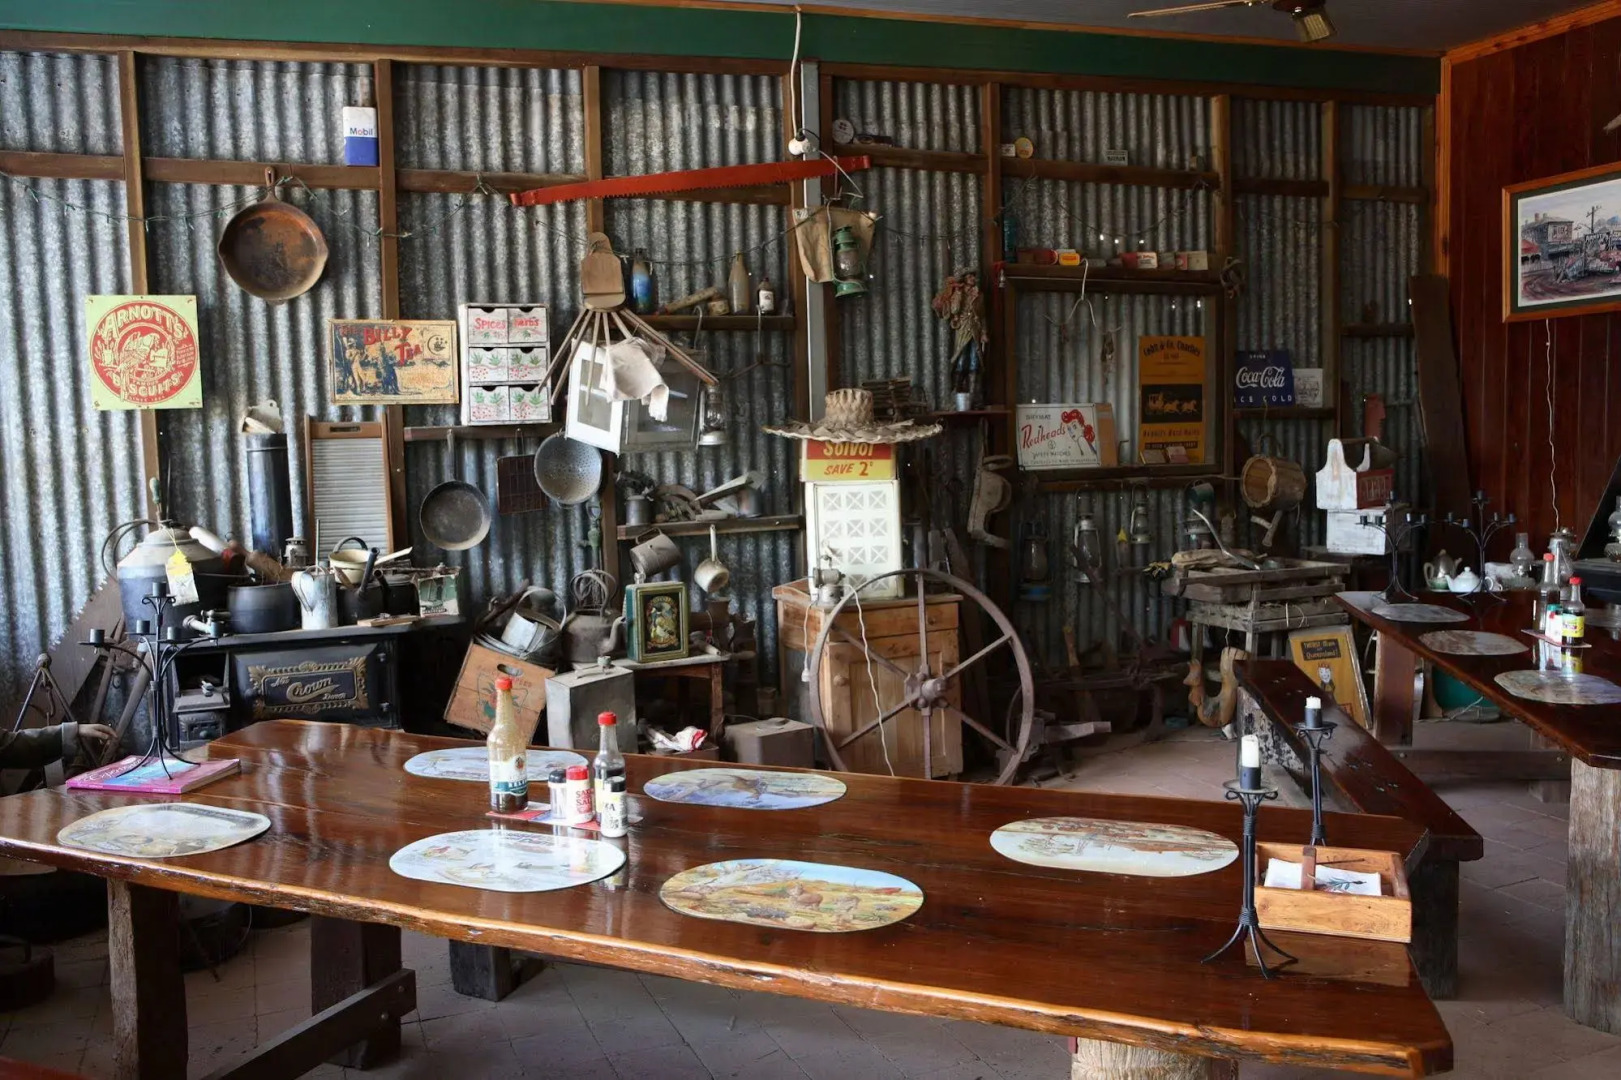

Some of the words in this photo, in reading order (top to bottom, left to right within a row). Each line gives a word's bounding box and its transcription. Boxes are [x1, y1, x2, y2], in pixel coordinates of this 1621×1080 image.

[350, 128, 373, 136] Mobil
[103, 305, 184, 341] ARNOTT'S
[364, 326, 412, 345] BILLY
[1236, 366, 1285, 388] Coca-Cola
[1262, 395, 1292, 403] COLD
[1021, 422, 1066, 449] Redheads
[824, 463, 855, 475] SAVE
[286, 677, 340, 703] Crown
